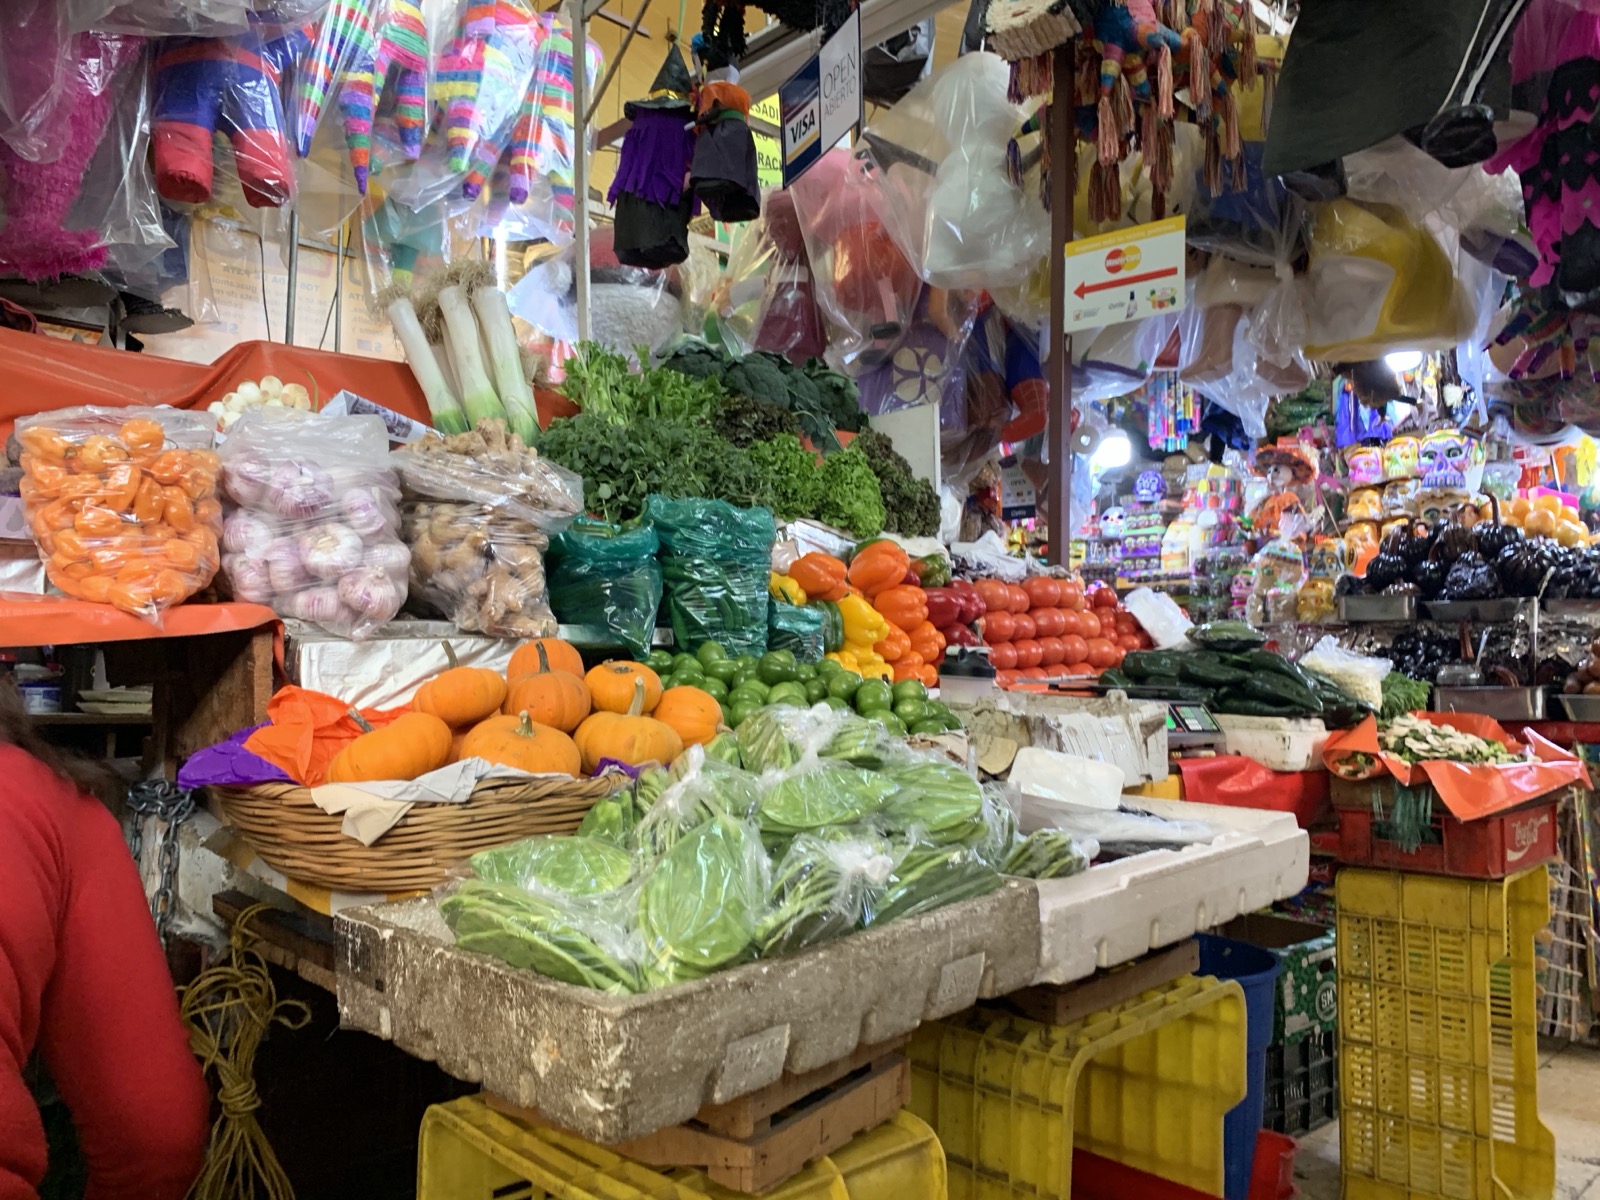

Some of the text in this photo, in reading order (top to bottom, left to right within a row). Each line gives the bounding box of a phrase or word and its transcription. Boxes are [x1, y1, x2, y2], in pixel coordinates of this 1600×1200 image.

[822, 46, 857, 99] OPEN
[751, 102, 780, 120] SADI
[823, 75, 857, 121] ABIERTO
[790, 108, 816, 144] VISA
